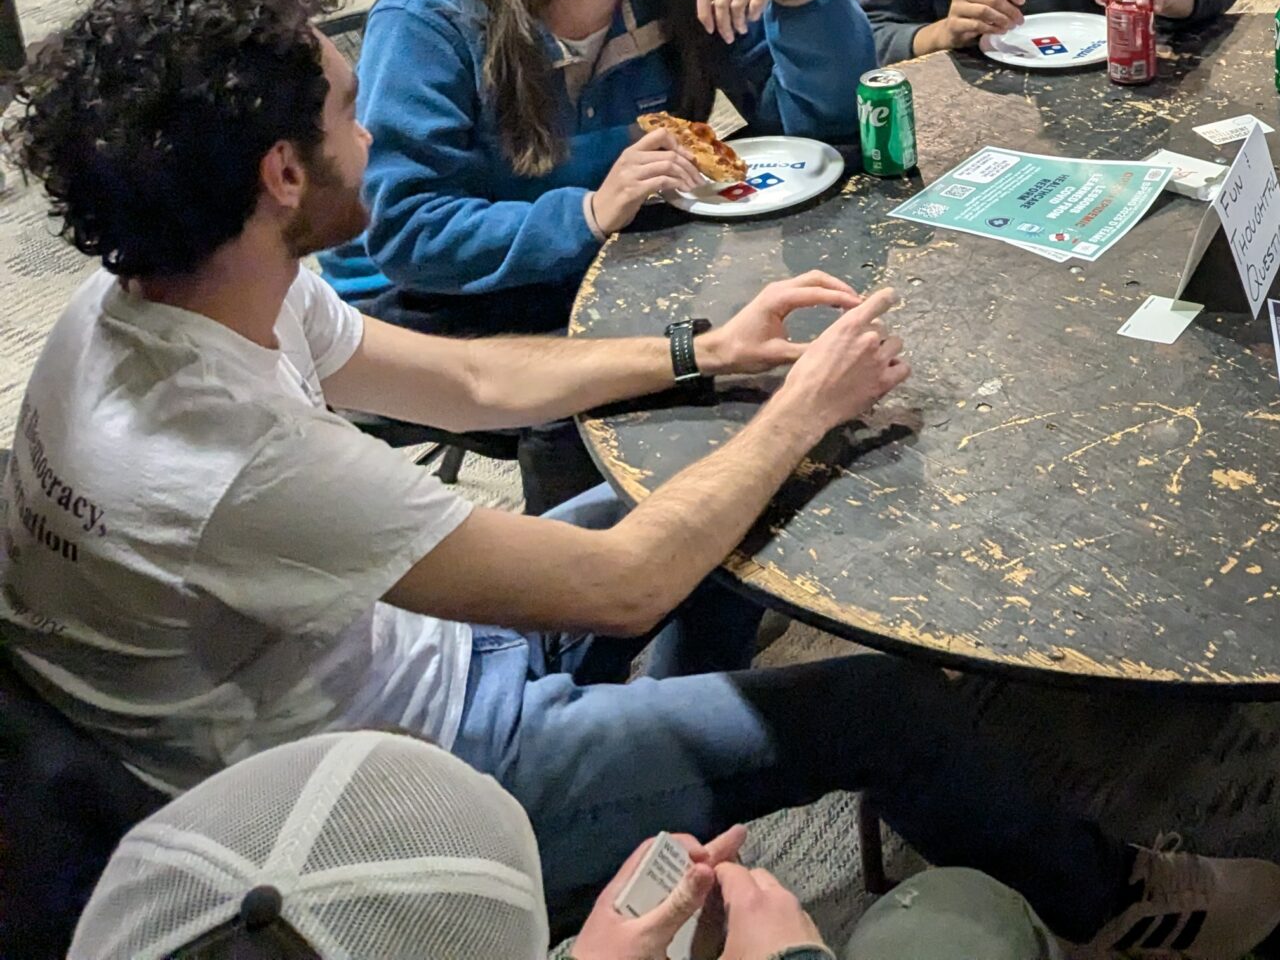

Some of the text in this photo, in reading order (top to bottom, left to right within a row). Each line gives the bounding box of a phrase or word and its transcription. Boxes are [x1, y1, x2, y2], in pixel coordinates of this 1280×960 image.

[857, 94, 890, 127] ite
[747, 161, 806, 170] Domi
[1016, 178, 1053, 202] REFORM
[1020, 174, 1069, 210] HEALTHCARE
[1046, 173, 1104, 219] LEARNED FROM
[1049, 186, 1076, 205] COVID
[1069, 184, 1107, 214] LESSONS
[1219, 175, 1244, 218] FUN
